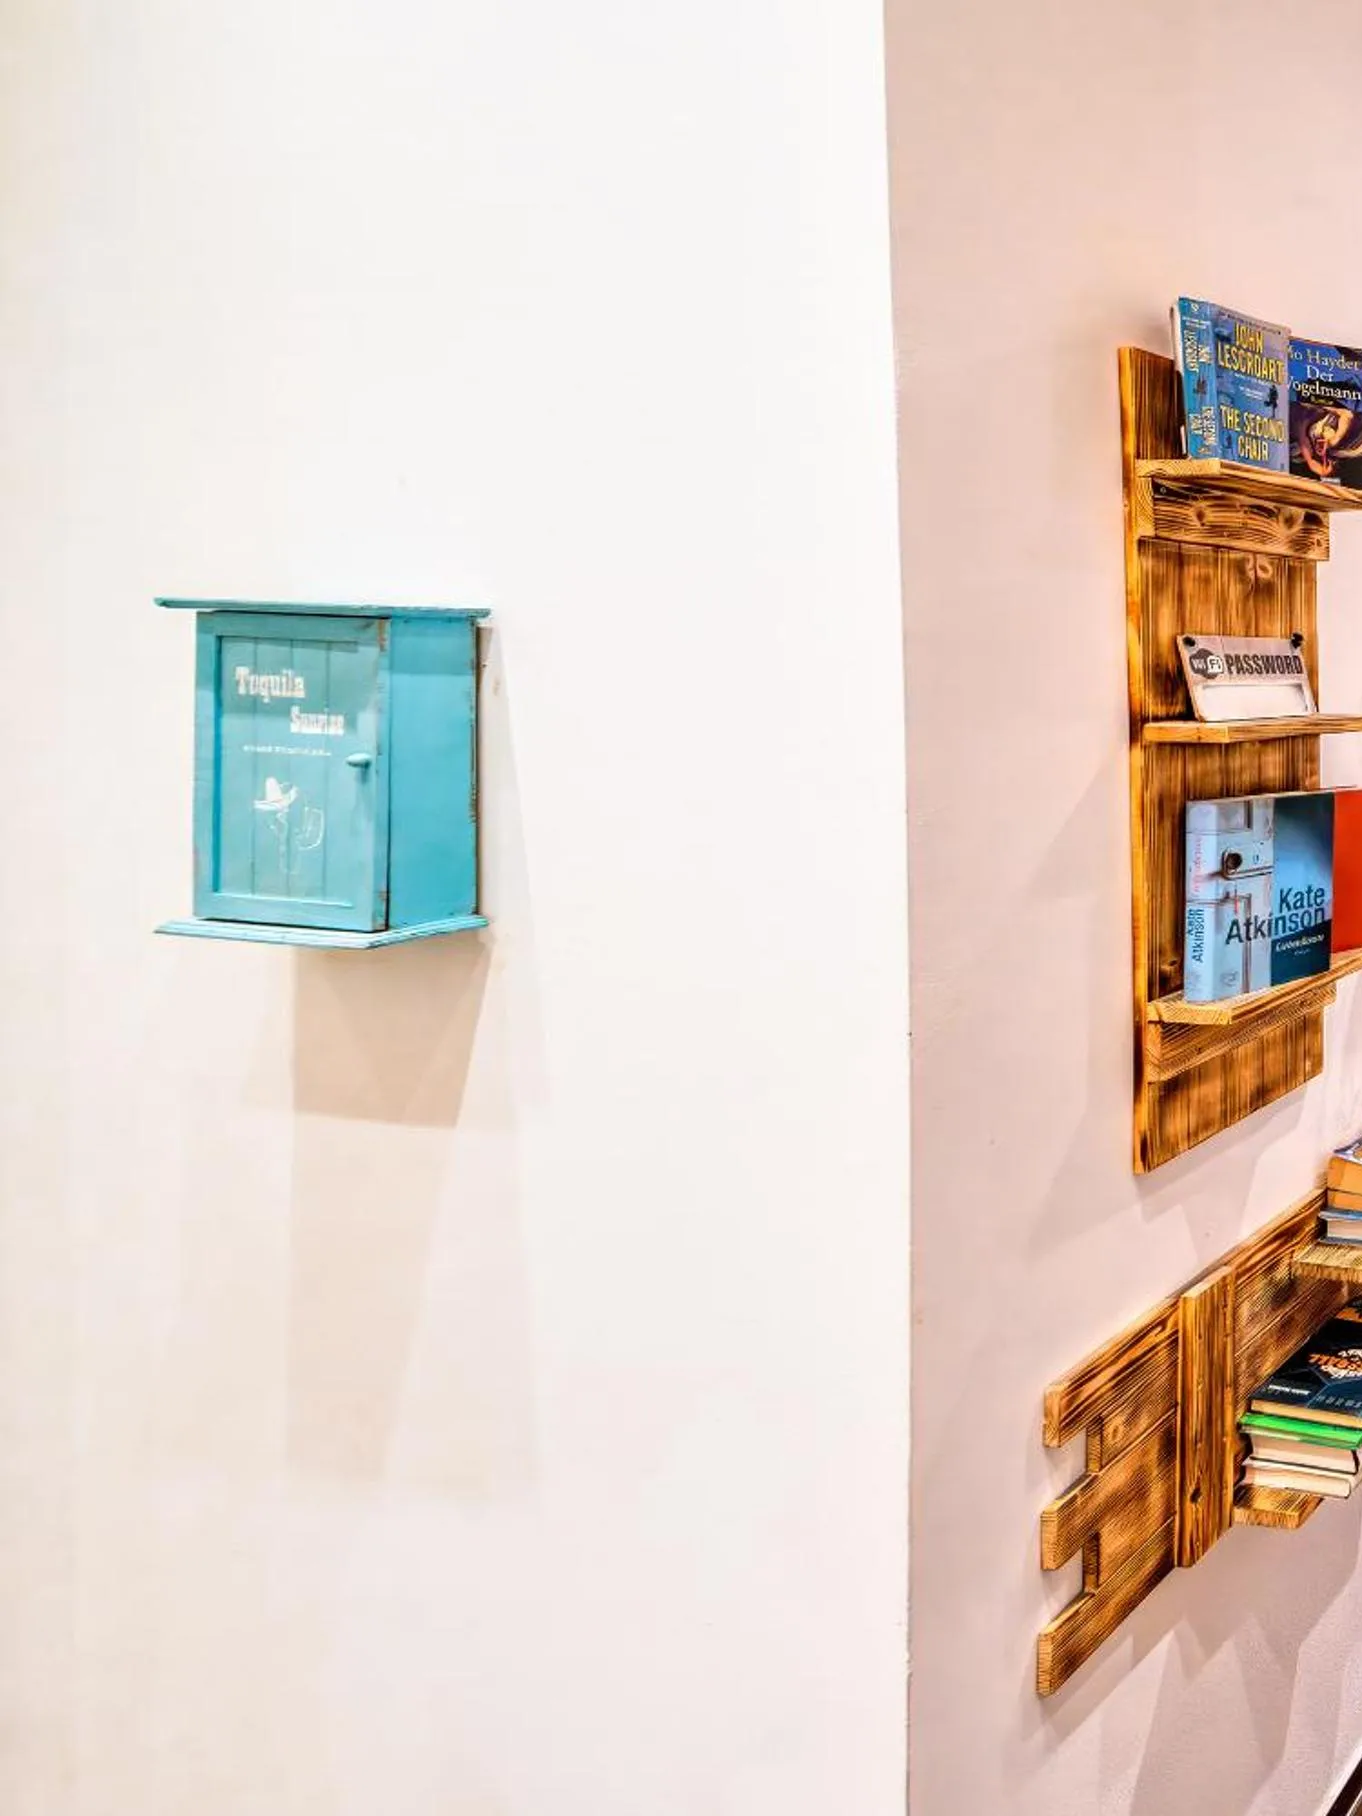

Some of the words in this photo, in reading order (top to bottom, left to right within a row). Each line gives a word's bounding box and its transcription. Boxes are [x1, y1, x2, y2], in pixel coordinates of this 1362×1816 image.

[1235, 322, 1265, 354] JOHN
[1217, 340, 1285, 386] LESCROART
[1306, 348, 1360, 371] Hayder
[1306, 364, 1334, 383] Der
[1220, 404, 1242, 431] THE
[1243, 411, 1285, 443] SECOND
[1237, 435, 1269, 462] CHAIR
[1224, 653, 1304, 675] PASSWORD
[235, 665, 306, 703] Tequila
[1279, 884, 1325, 914] Kate
[1191, 908, 1205, 964] Atkinson
[1225, 907, 1325, 945] Atkinson
